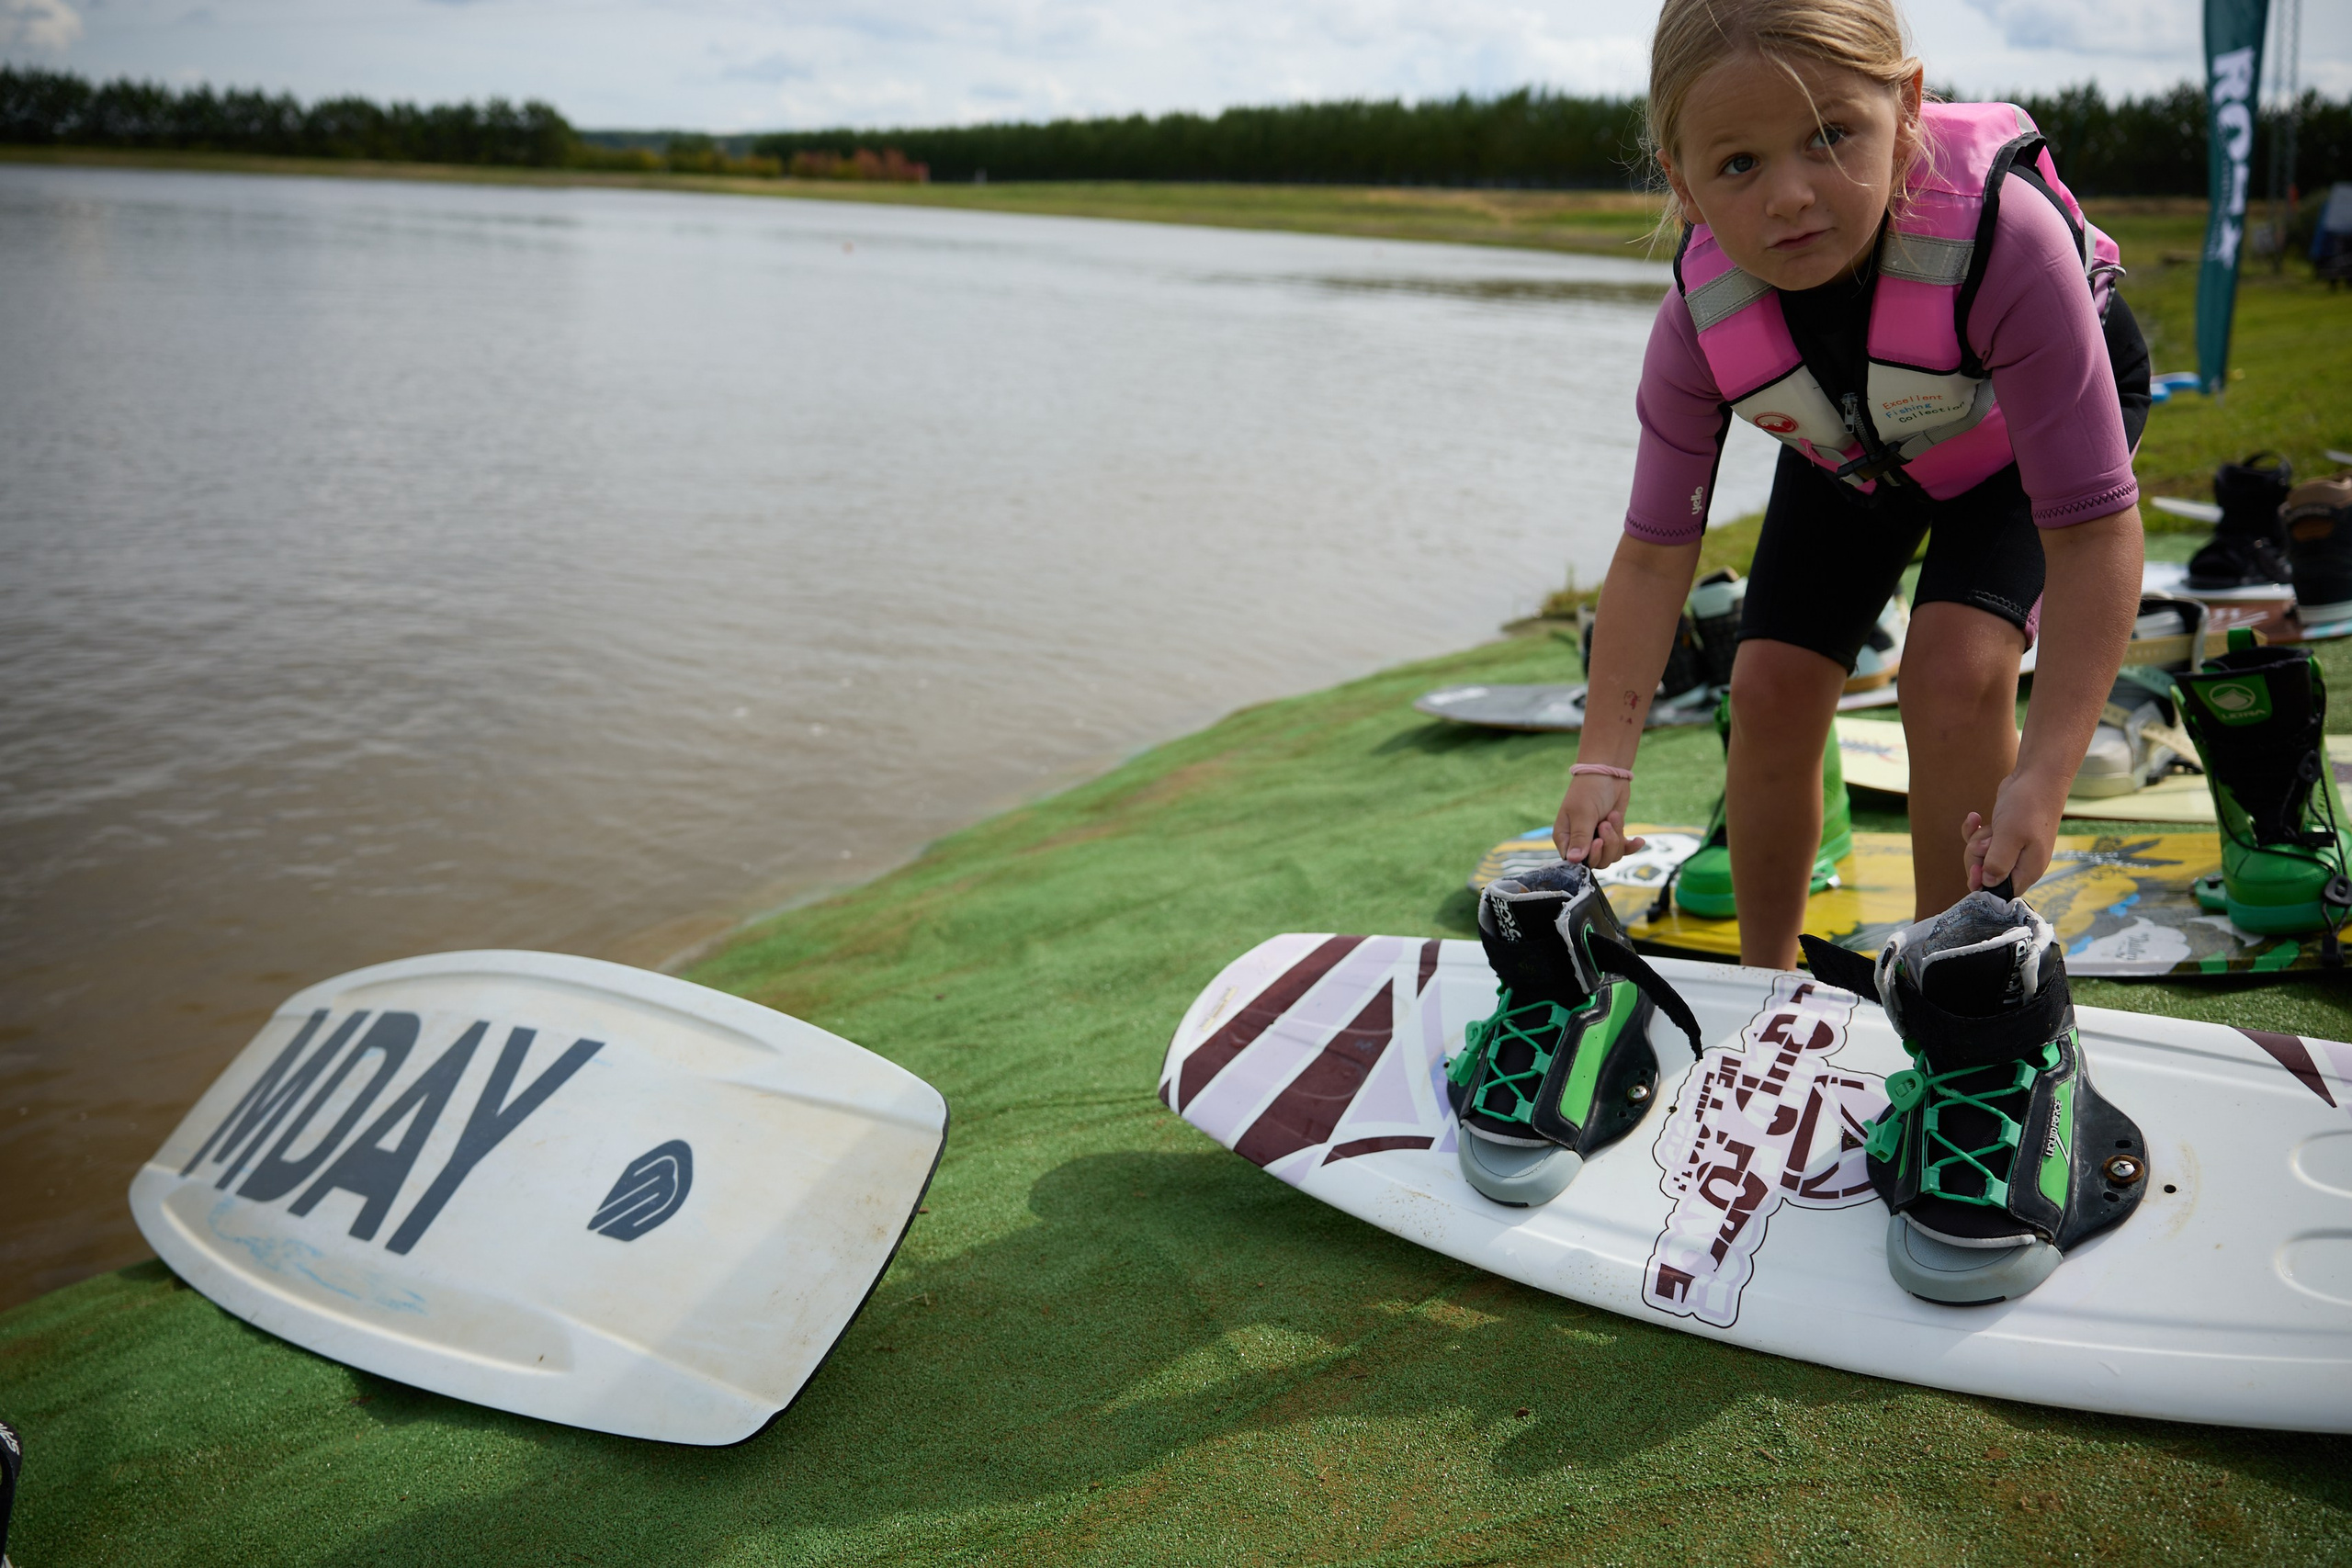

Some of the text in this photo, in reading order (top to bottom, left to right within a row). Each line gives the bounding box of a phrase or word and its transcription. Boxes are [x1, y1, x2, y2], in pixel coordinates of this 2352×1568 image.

[1883, 394, 1943, 411] Excellent
[1885, 402, 1932, 419] Fishing
[1898, 400, 1965, 423] Collection
[1690, 485, 1703, 515] yello
[178, 1007, 606, 1257] MDAY
